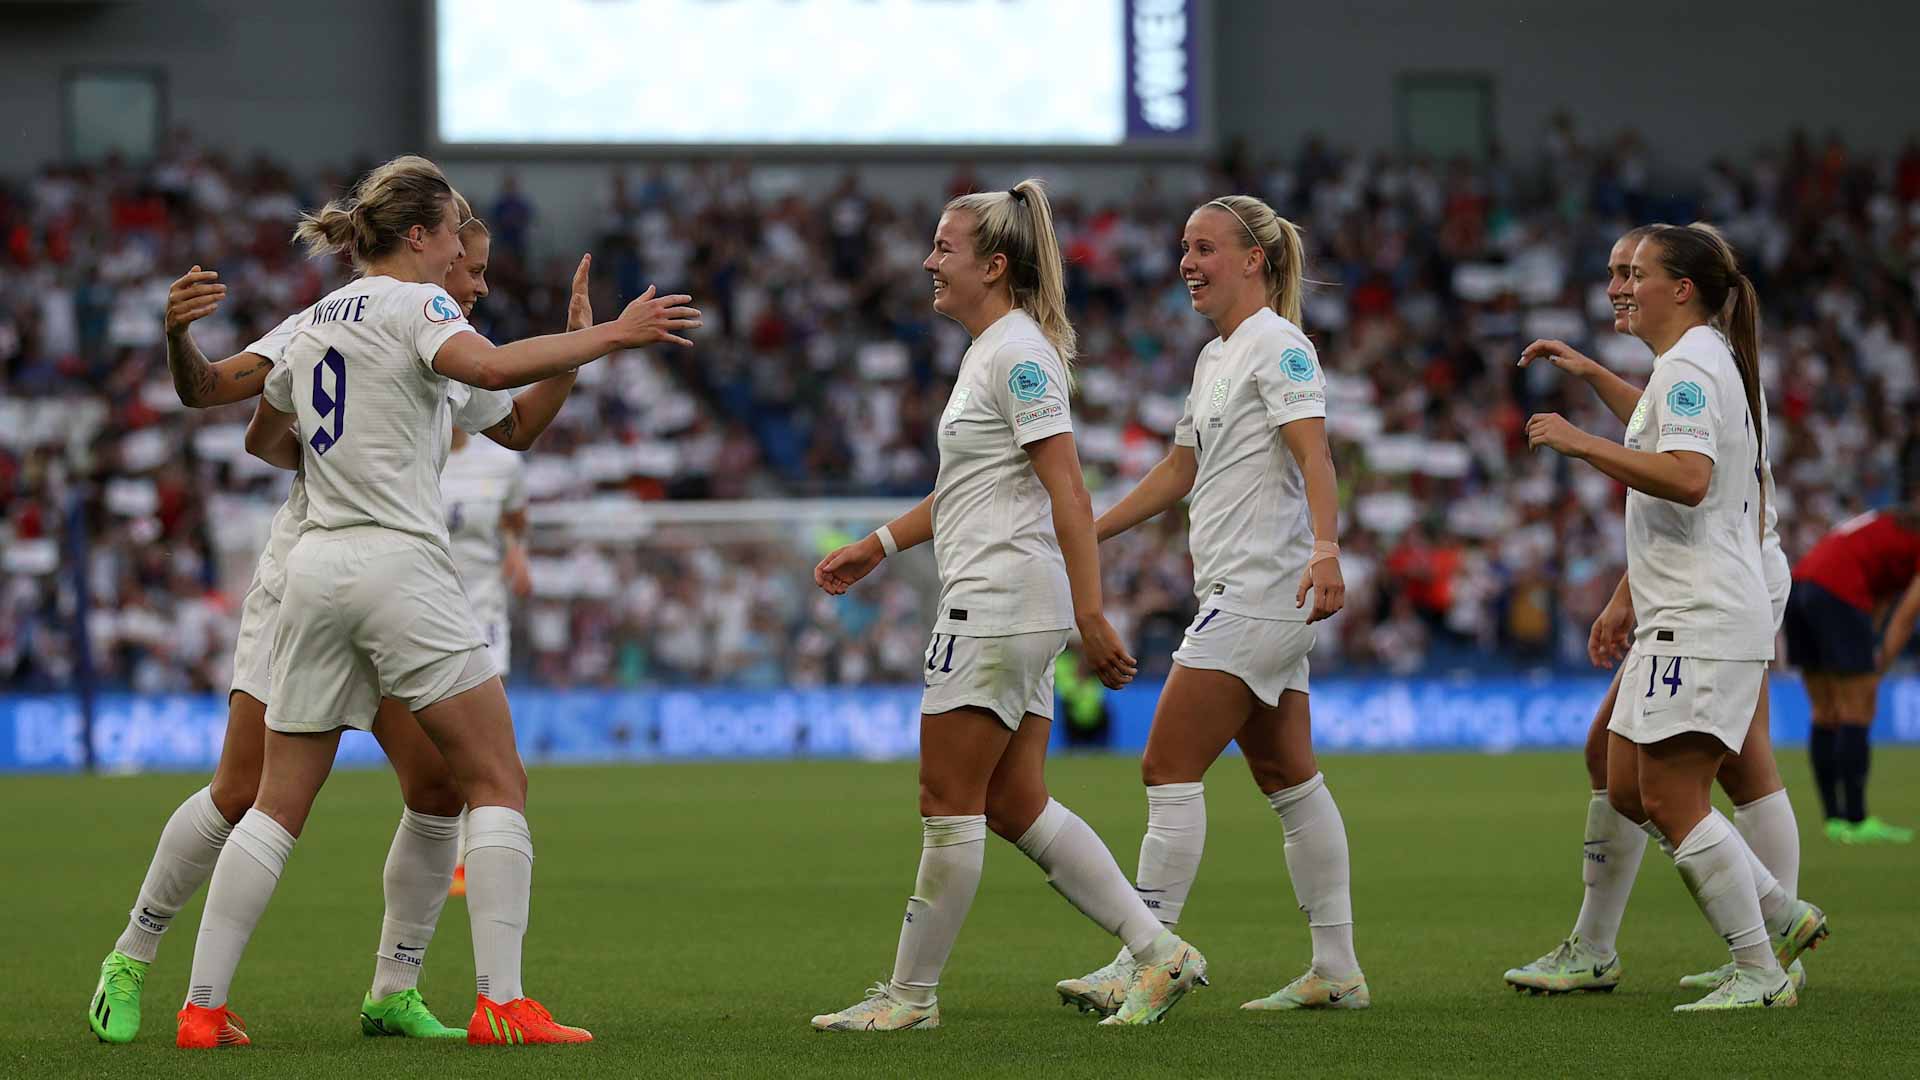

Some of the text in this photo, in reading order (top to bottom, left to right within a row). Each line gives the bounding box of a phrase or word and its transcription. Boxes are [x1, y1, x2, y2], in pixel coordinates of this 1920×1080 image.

[311, 295, 369, 326] WHITE
[309, 345, 346, 456] 9
[928, 632, 956, 673] 11
[1645, 655, 1682, 698] 14
[1308, 690, 1602, 758] ooking.co
